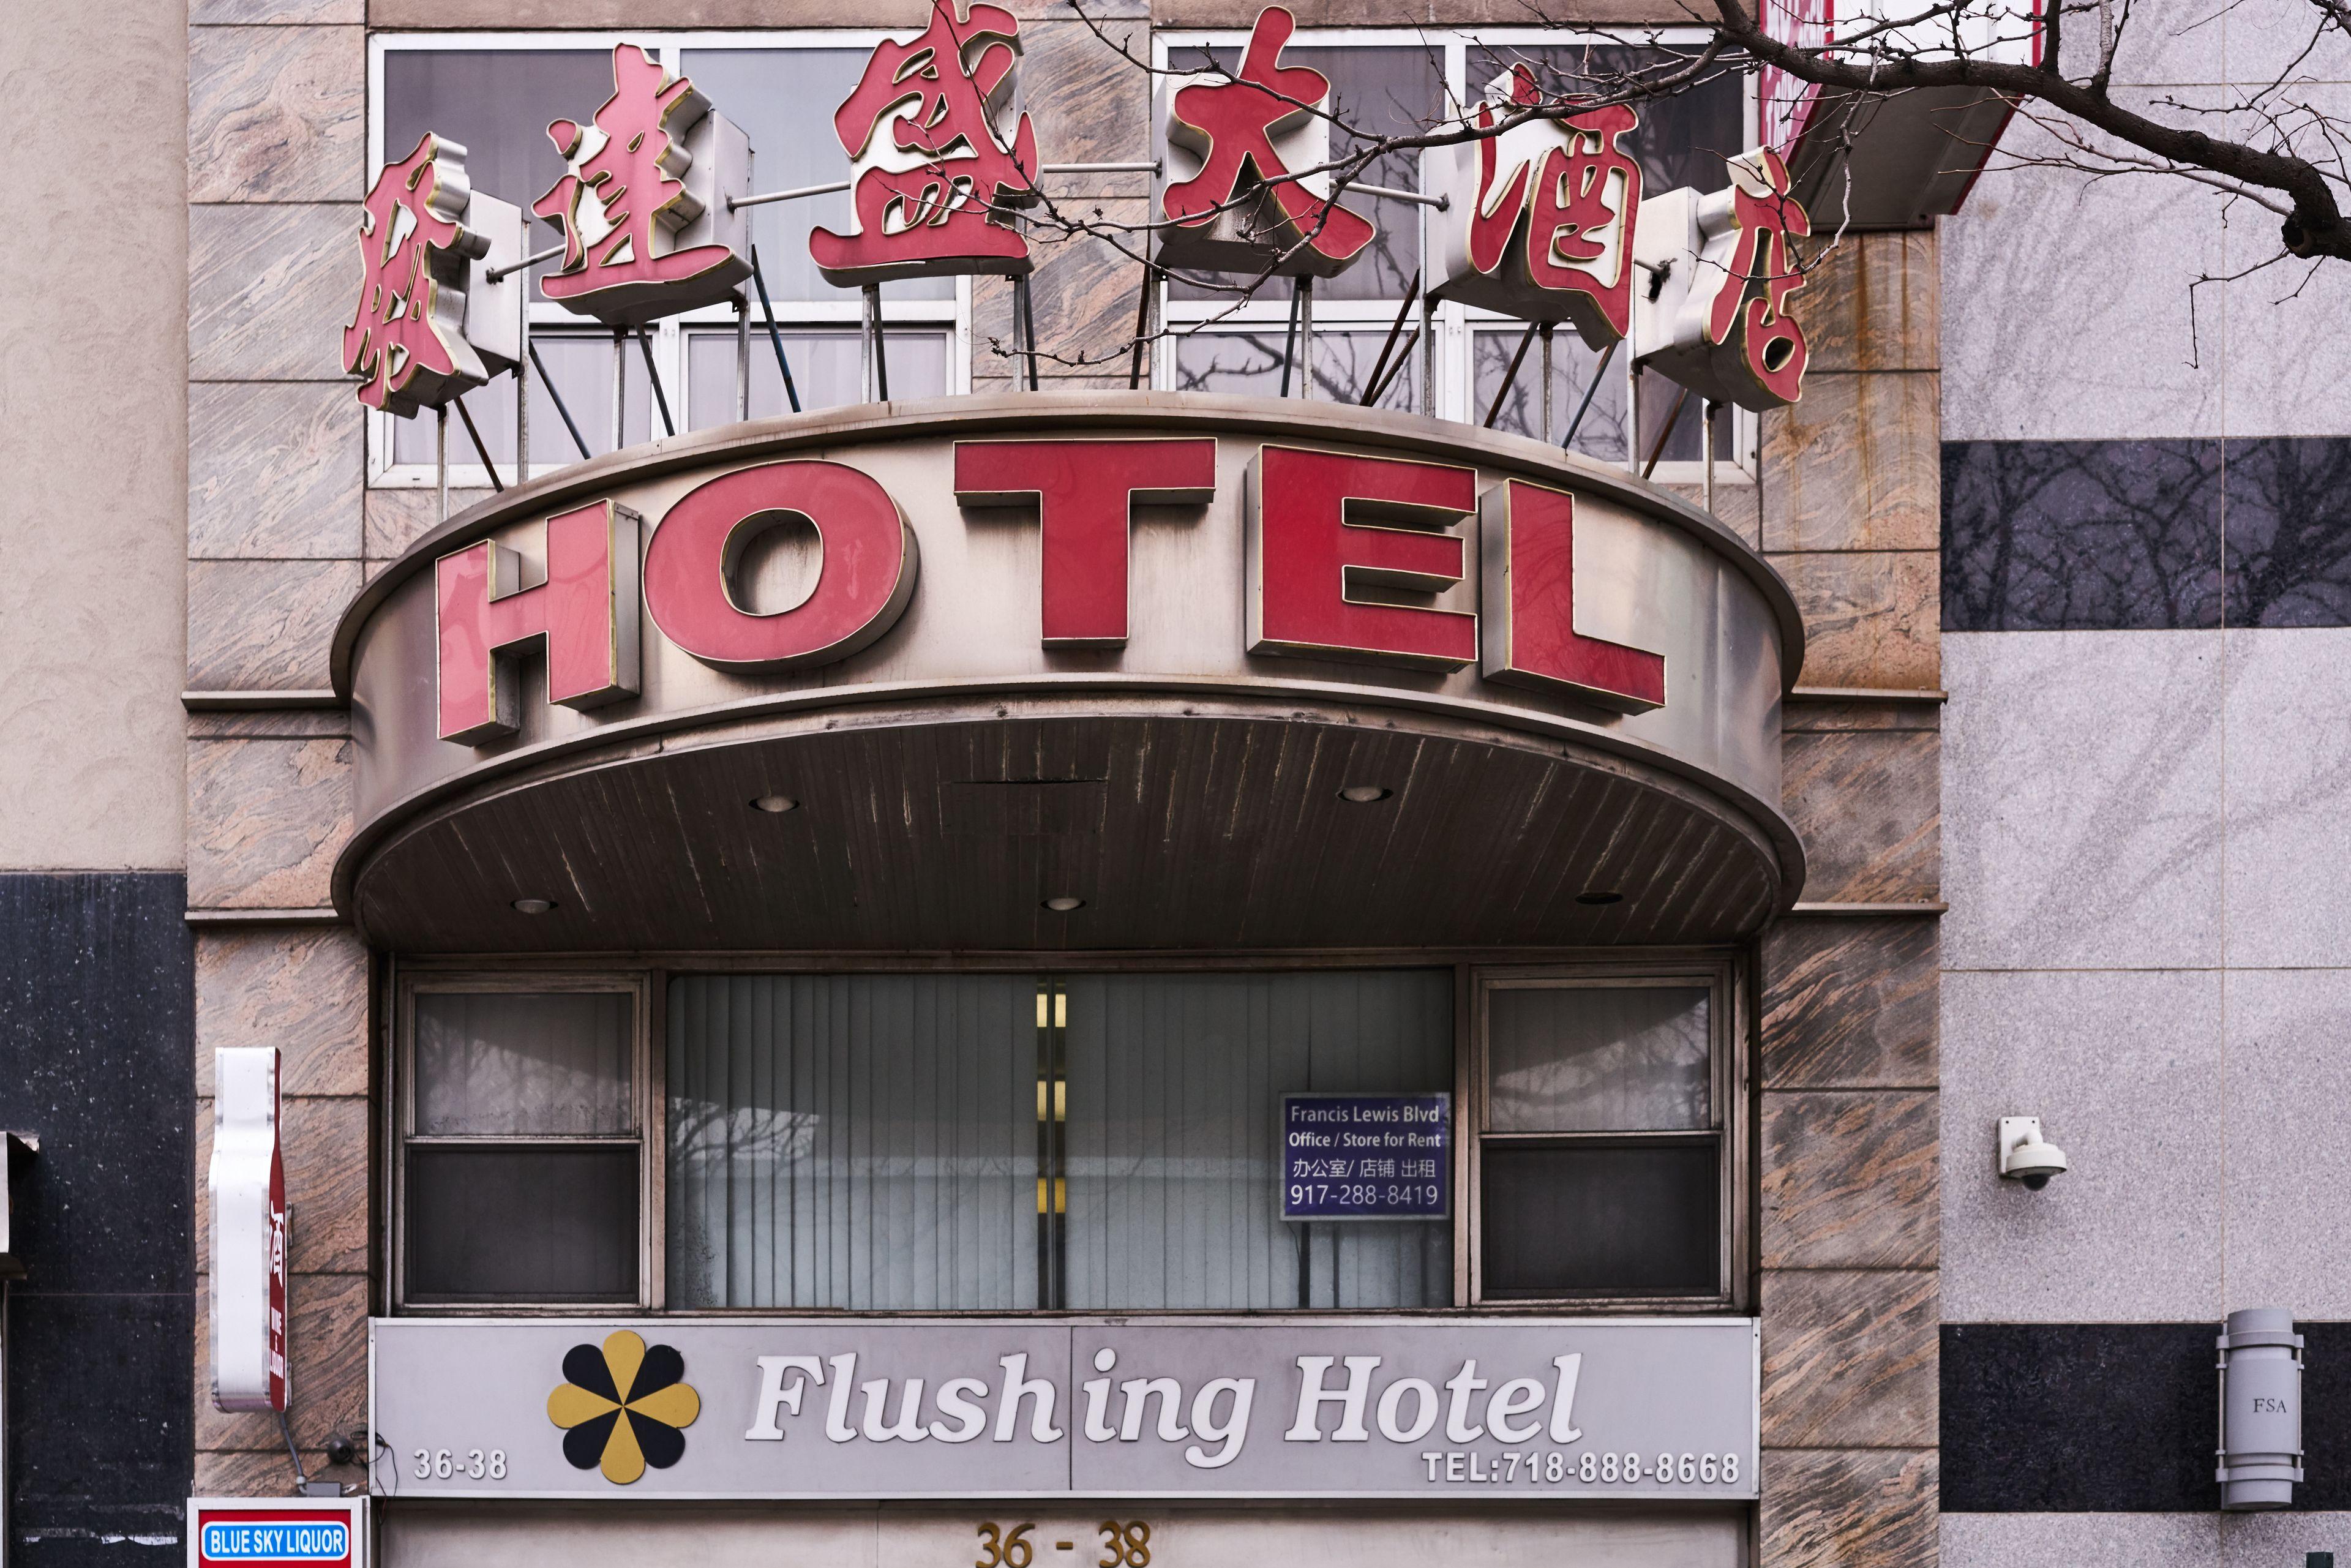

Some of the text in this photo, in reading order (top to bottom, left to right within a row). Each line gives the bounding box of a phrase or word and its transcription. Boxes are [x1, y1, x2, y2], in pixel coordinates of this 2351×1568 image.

[435, 435, 1667, 747] HOTEL
[1291, 1105, 1439, 1123] Francis Lewis Blvd
[1289, 1131, 1330, 1147] Office
[1343, 1132, 1381, 1147] Store
[1384, 1131, 1404, 1147] for
[1408, 1132, 1441, 1147] Rent
[1401, 1158, 1436, 1179] 出租
[1291, 1184, 1438, 1205] 917-288-8419
[744, 1347, 1583, 1469] Flushing Hotel
[2253, 1398, 2287, 1413] FSA
[413, 1447, 508, 1480] 36-38
[1421, 1451, 1741, 1484] TEL:718-888-8668
[211, 1529, 343, 1555] BLUE SKY LIQUOR
